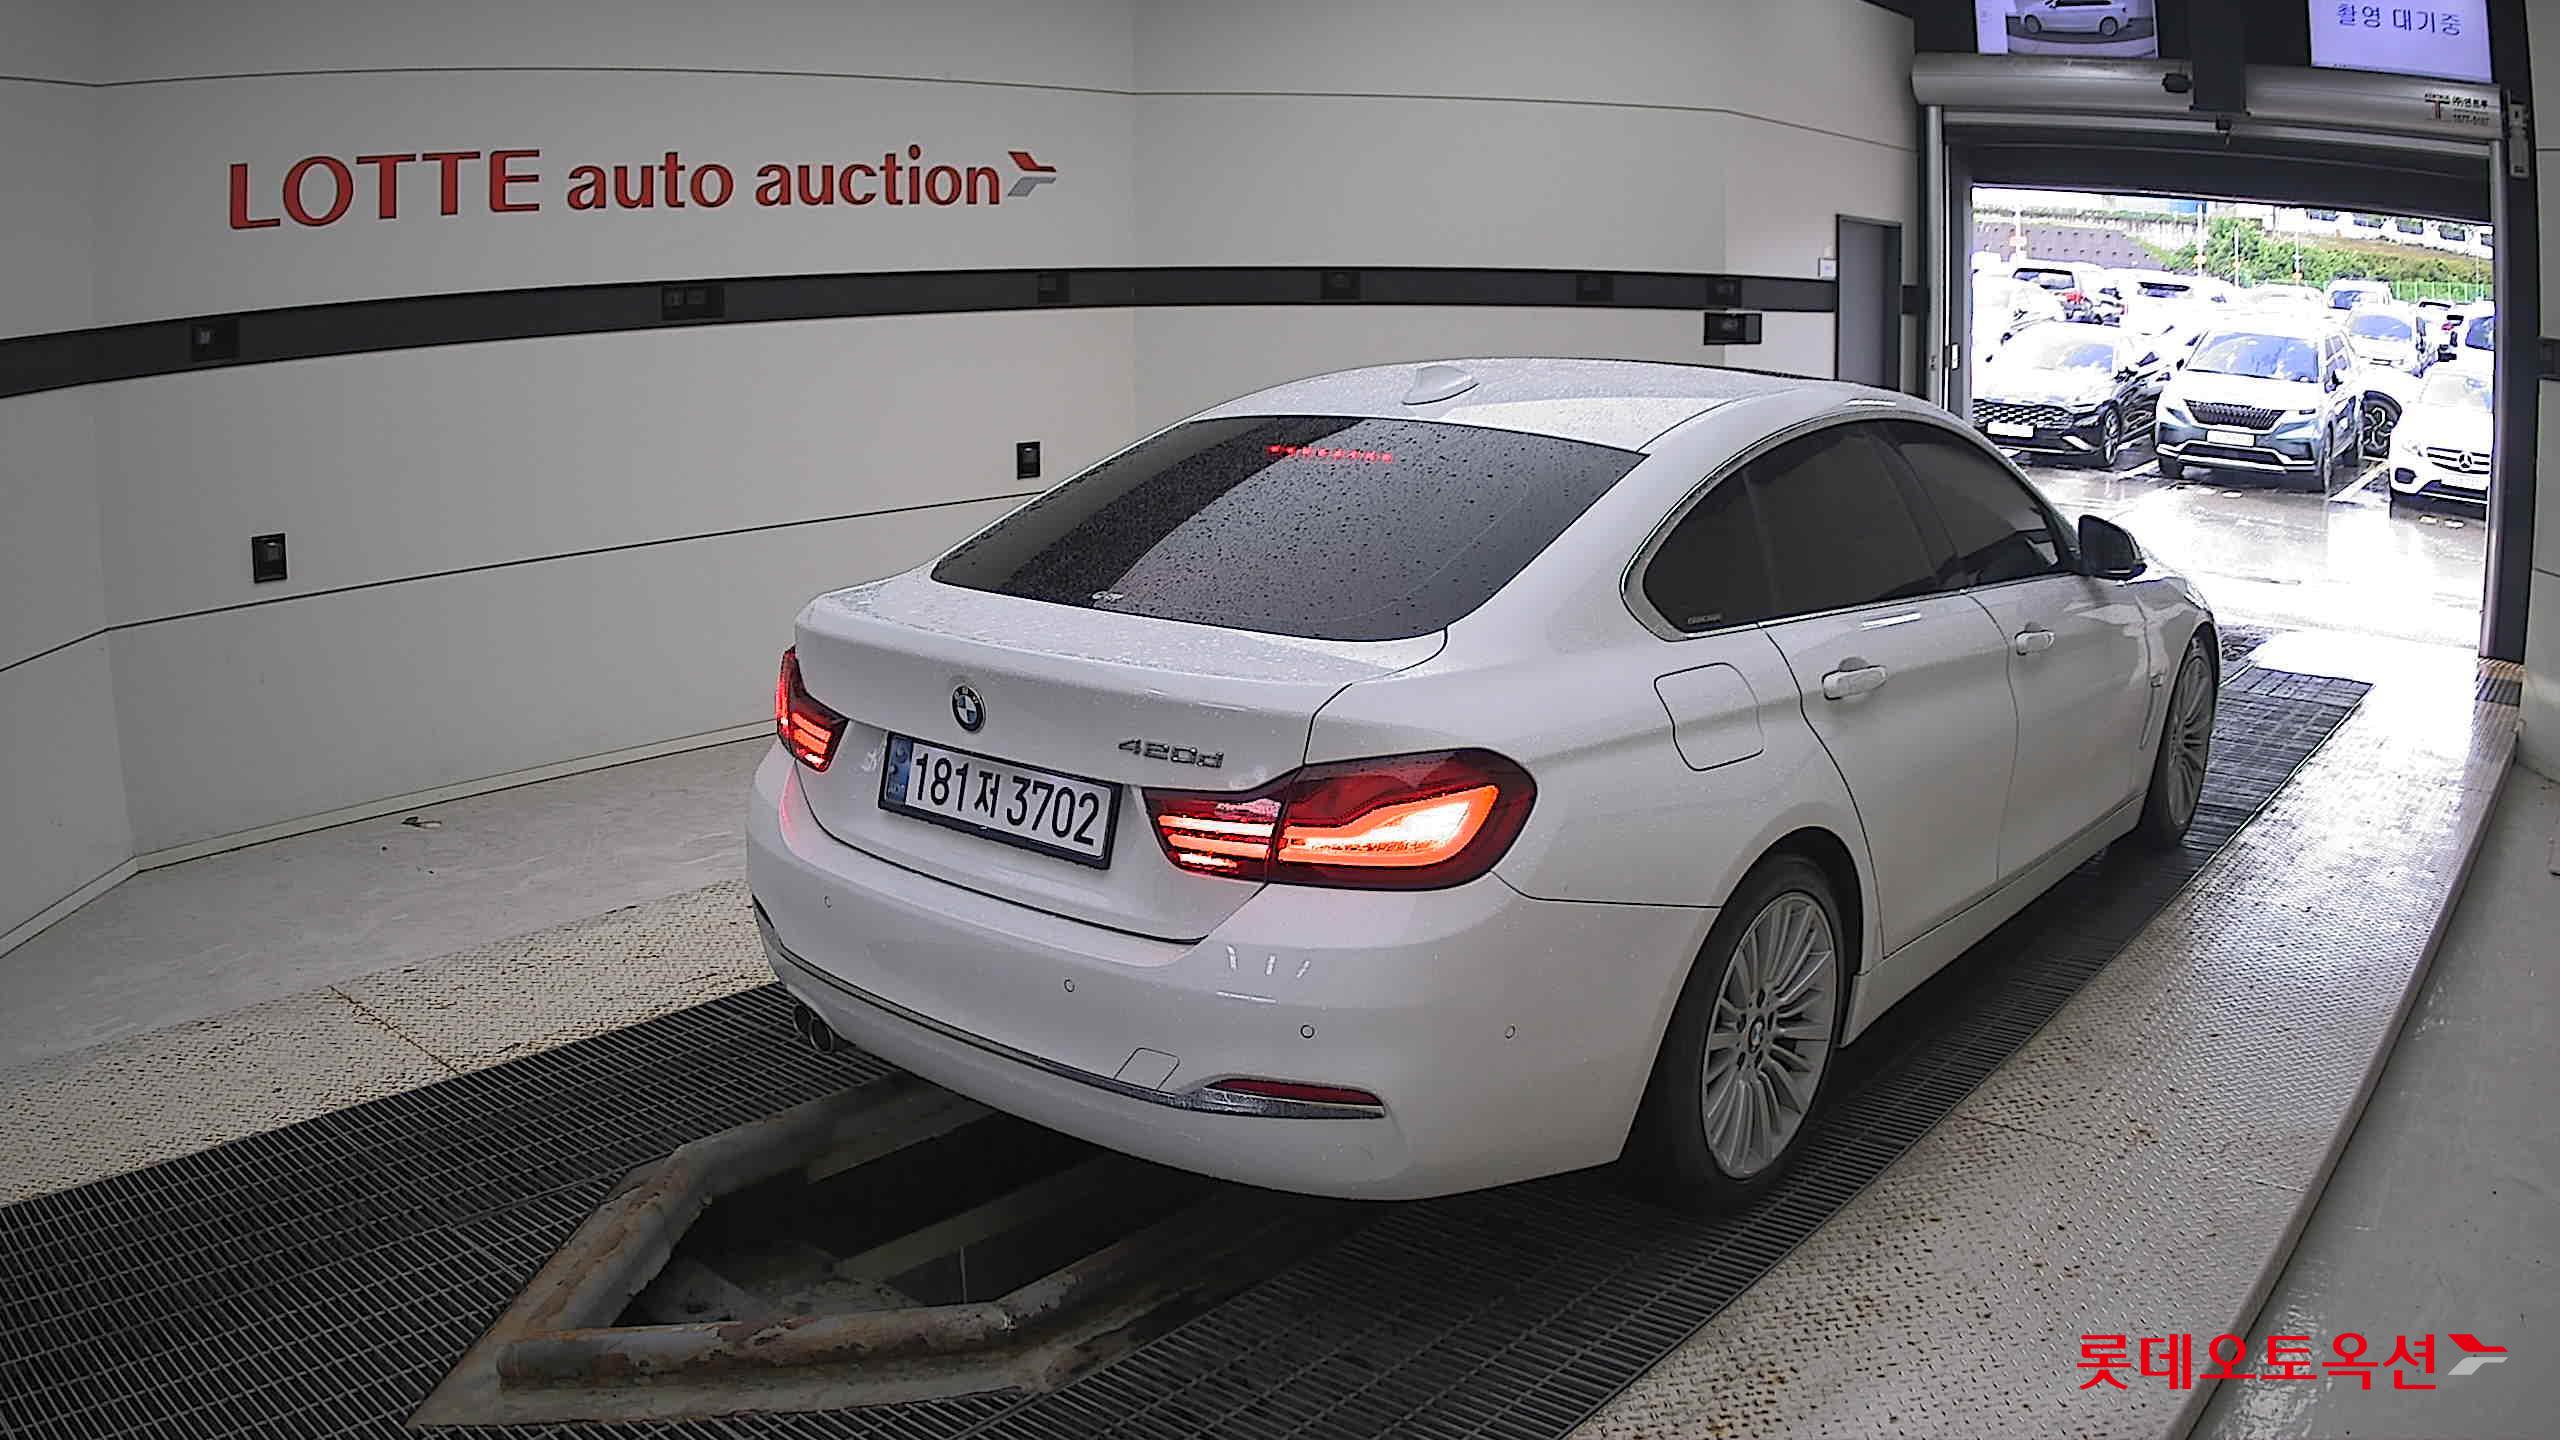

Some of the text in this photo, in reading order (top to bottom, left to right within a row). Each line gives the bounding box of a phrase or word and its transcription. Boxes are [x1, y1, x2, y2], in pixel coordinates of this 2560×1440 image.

[2393, 8, 2461, 36] 대기중
[229, 144, 1001, 230] LOTTE auto auction
